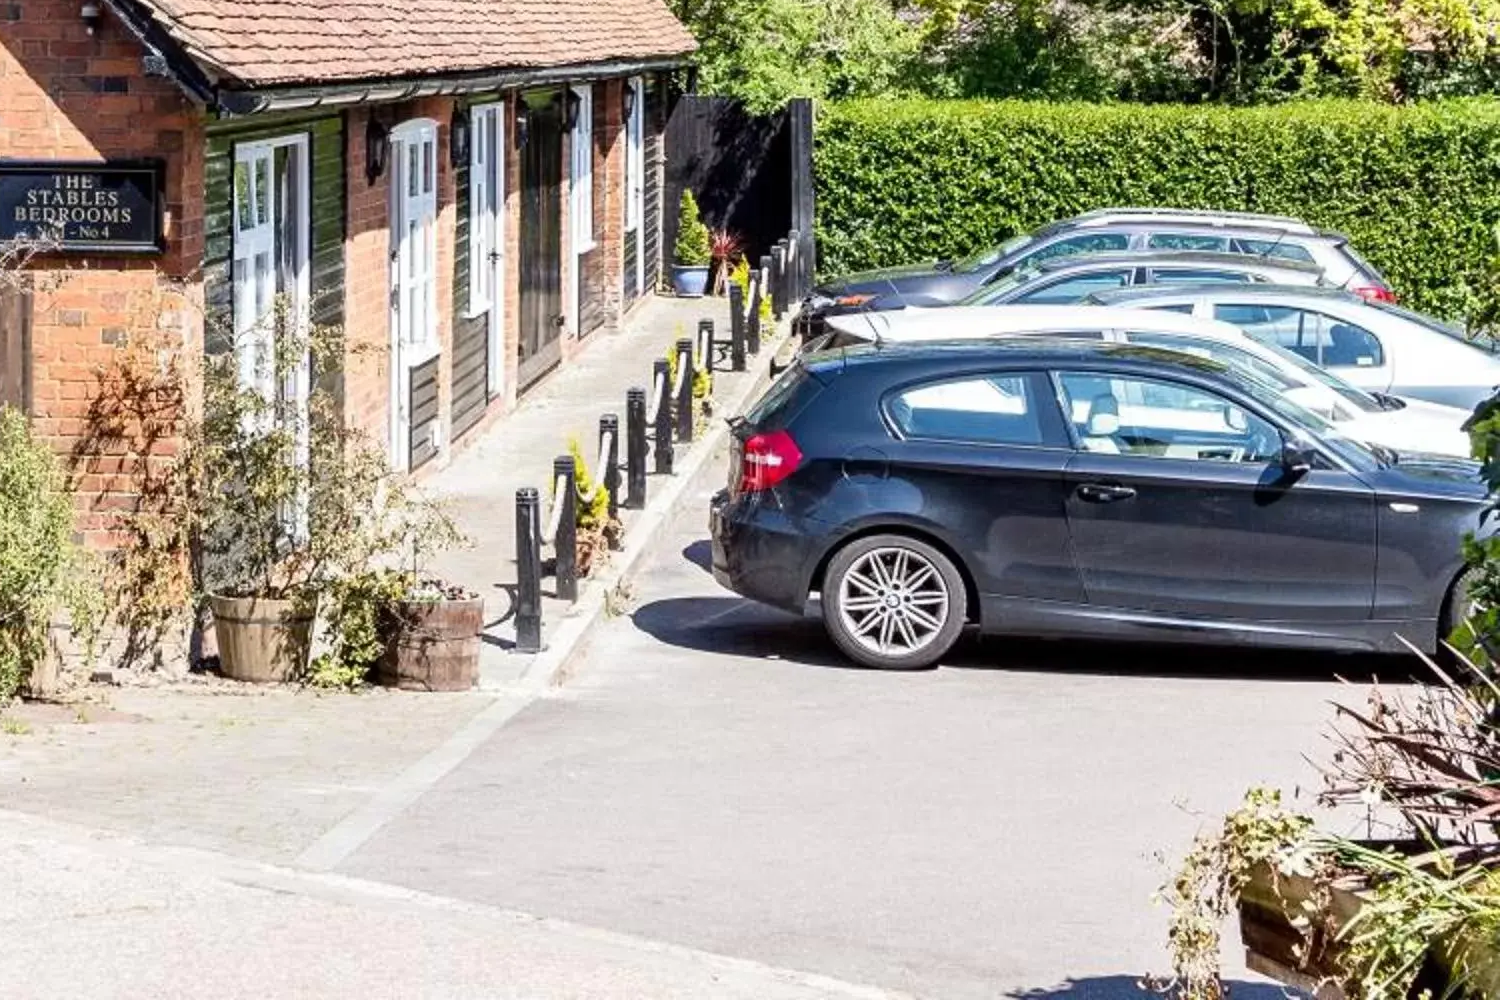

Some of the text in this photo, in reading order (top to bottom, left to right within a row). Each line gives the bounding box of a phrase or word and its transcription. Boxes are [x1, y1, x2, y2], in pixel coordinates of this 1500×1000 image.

[52, 175, 93, 189] THE
[27, 189, 118, 206] STABLES
[15, 207, 131, 223] BEDROOMS
[101, 226, 109, 239] 4
